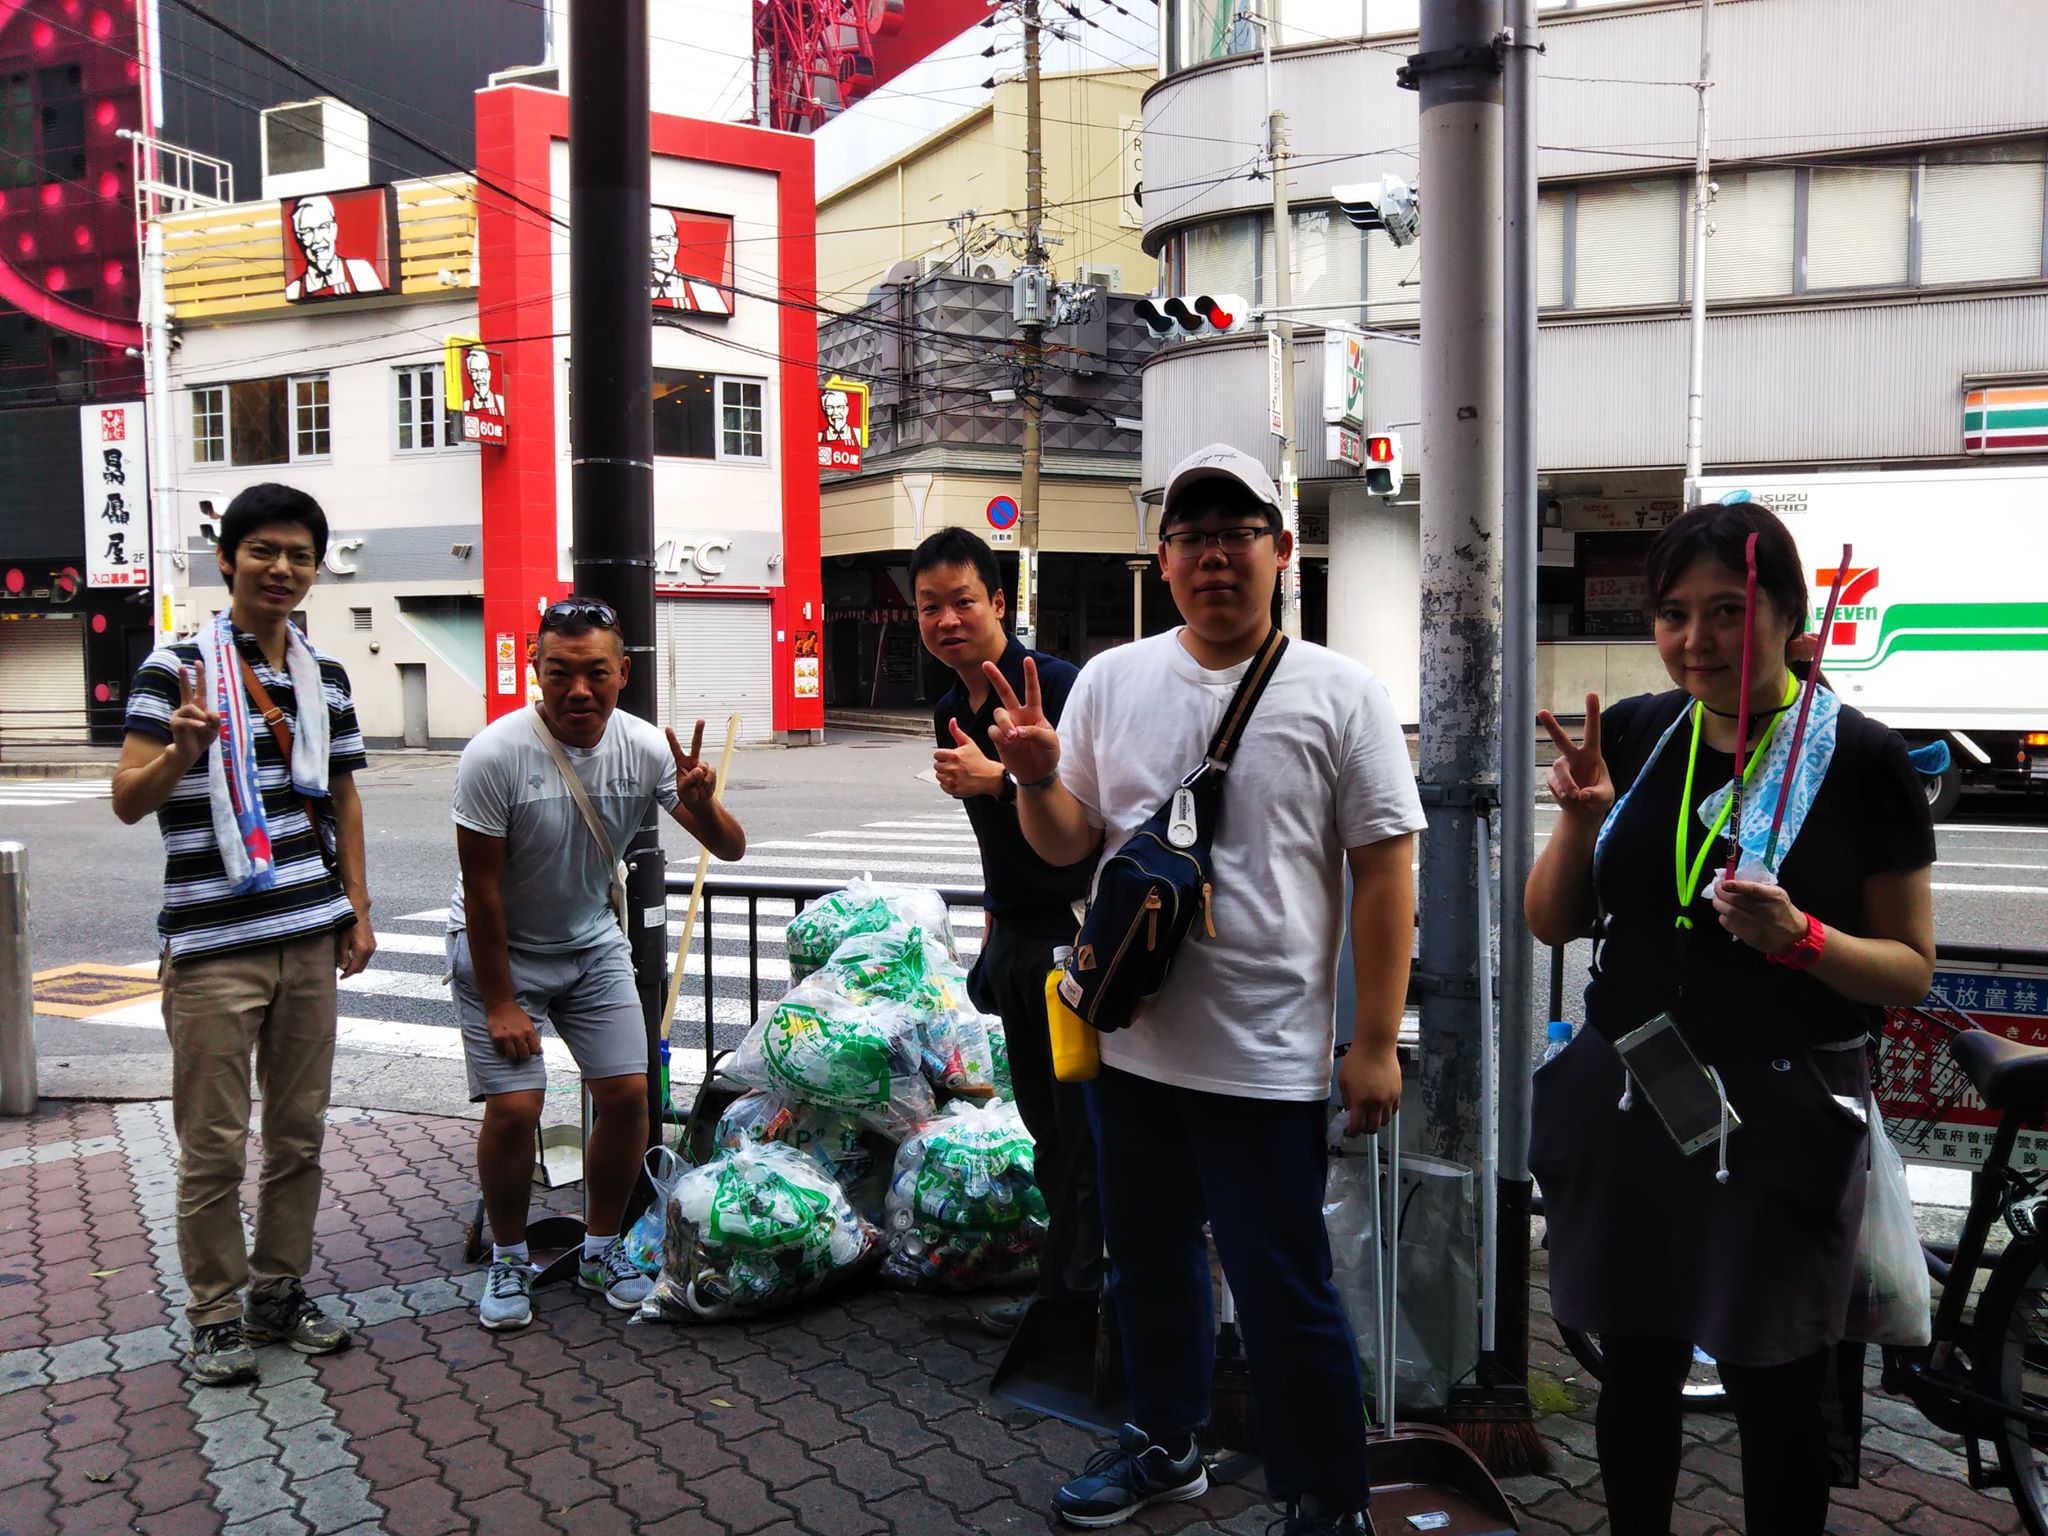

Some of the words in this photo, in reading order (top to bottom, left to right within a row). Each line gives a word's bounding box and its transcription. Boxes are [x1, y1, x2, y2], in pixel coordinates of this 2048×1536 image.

[1760, 493, 1808, 503] ISUZU
[132, 553, 145, 564] 2F
[91, 572, 130, 585] 入口裏側
[1815, 566, 1880, 645] 7
[1815, 606, 1878, 621] EEVEn
[1917, 1142, 1983, 1160] 大阪市
[2023, 1151, 2038, 1166] 設
